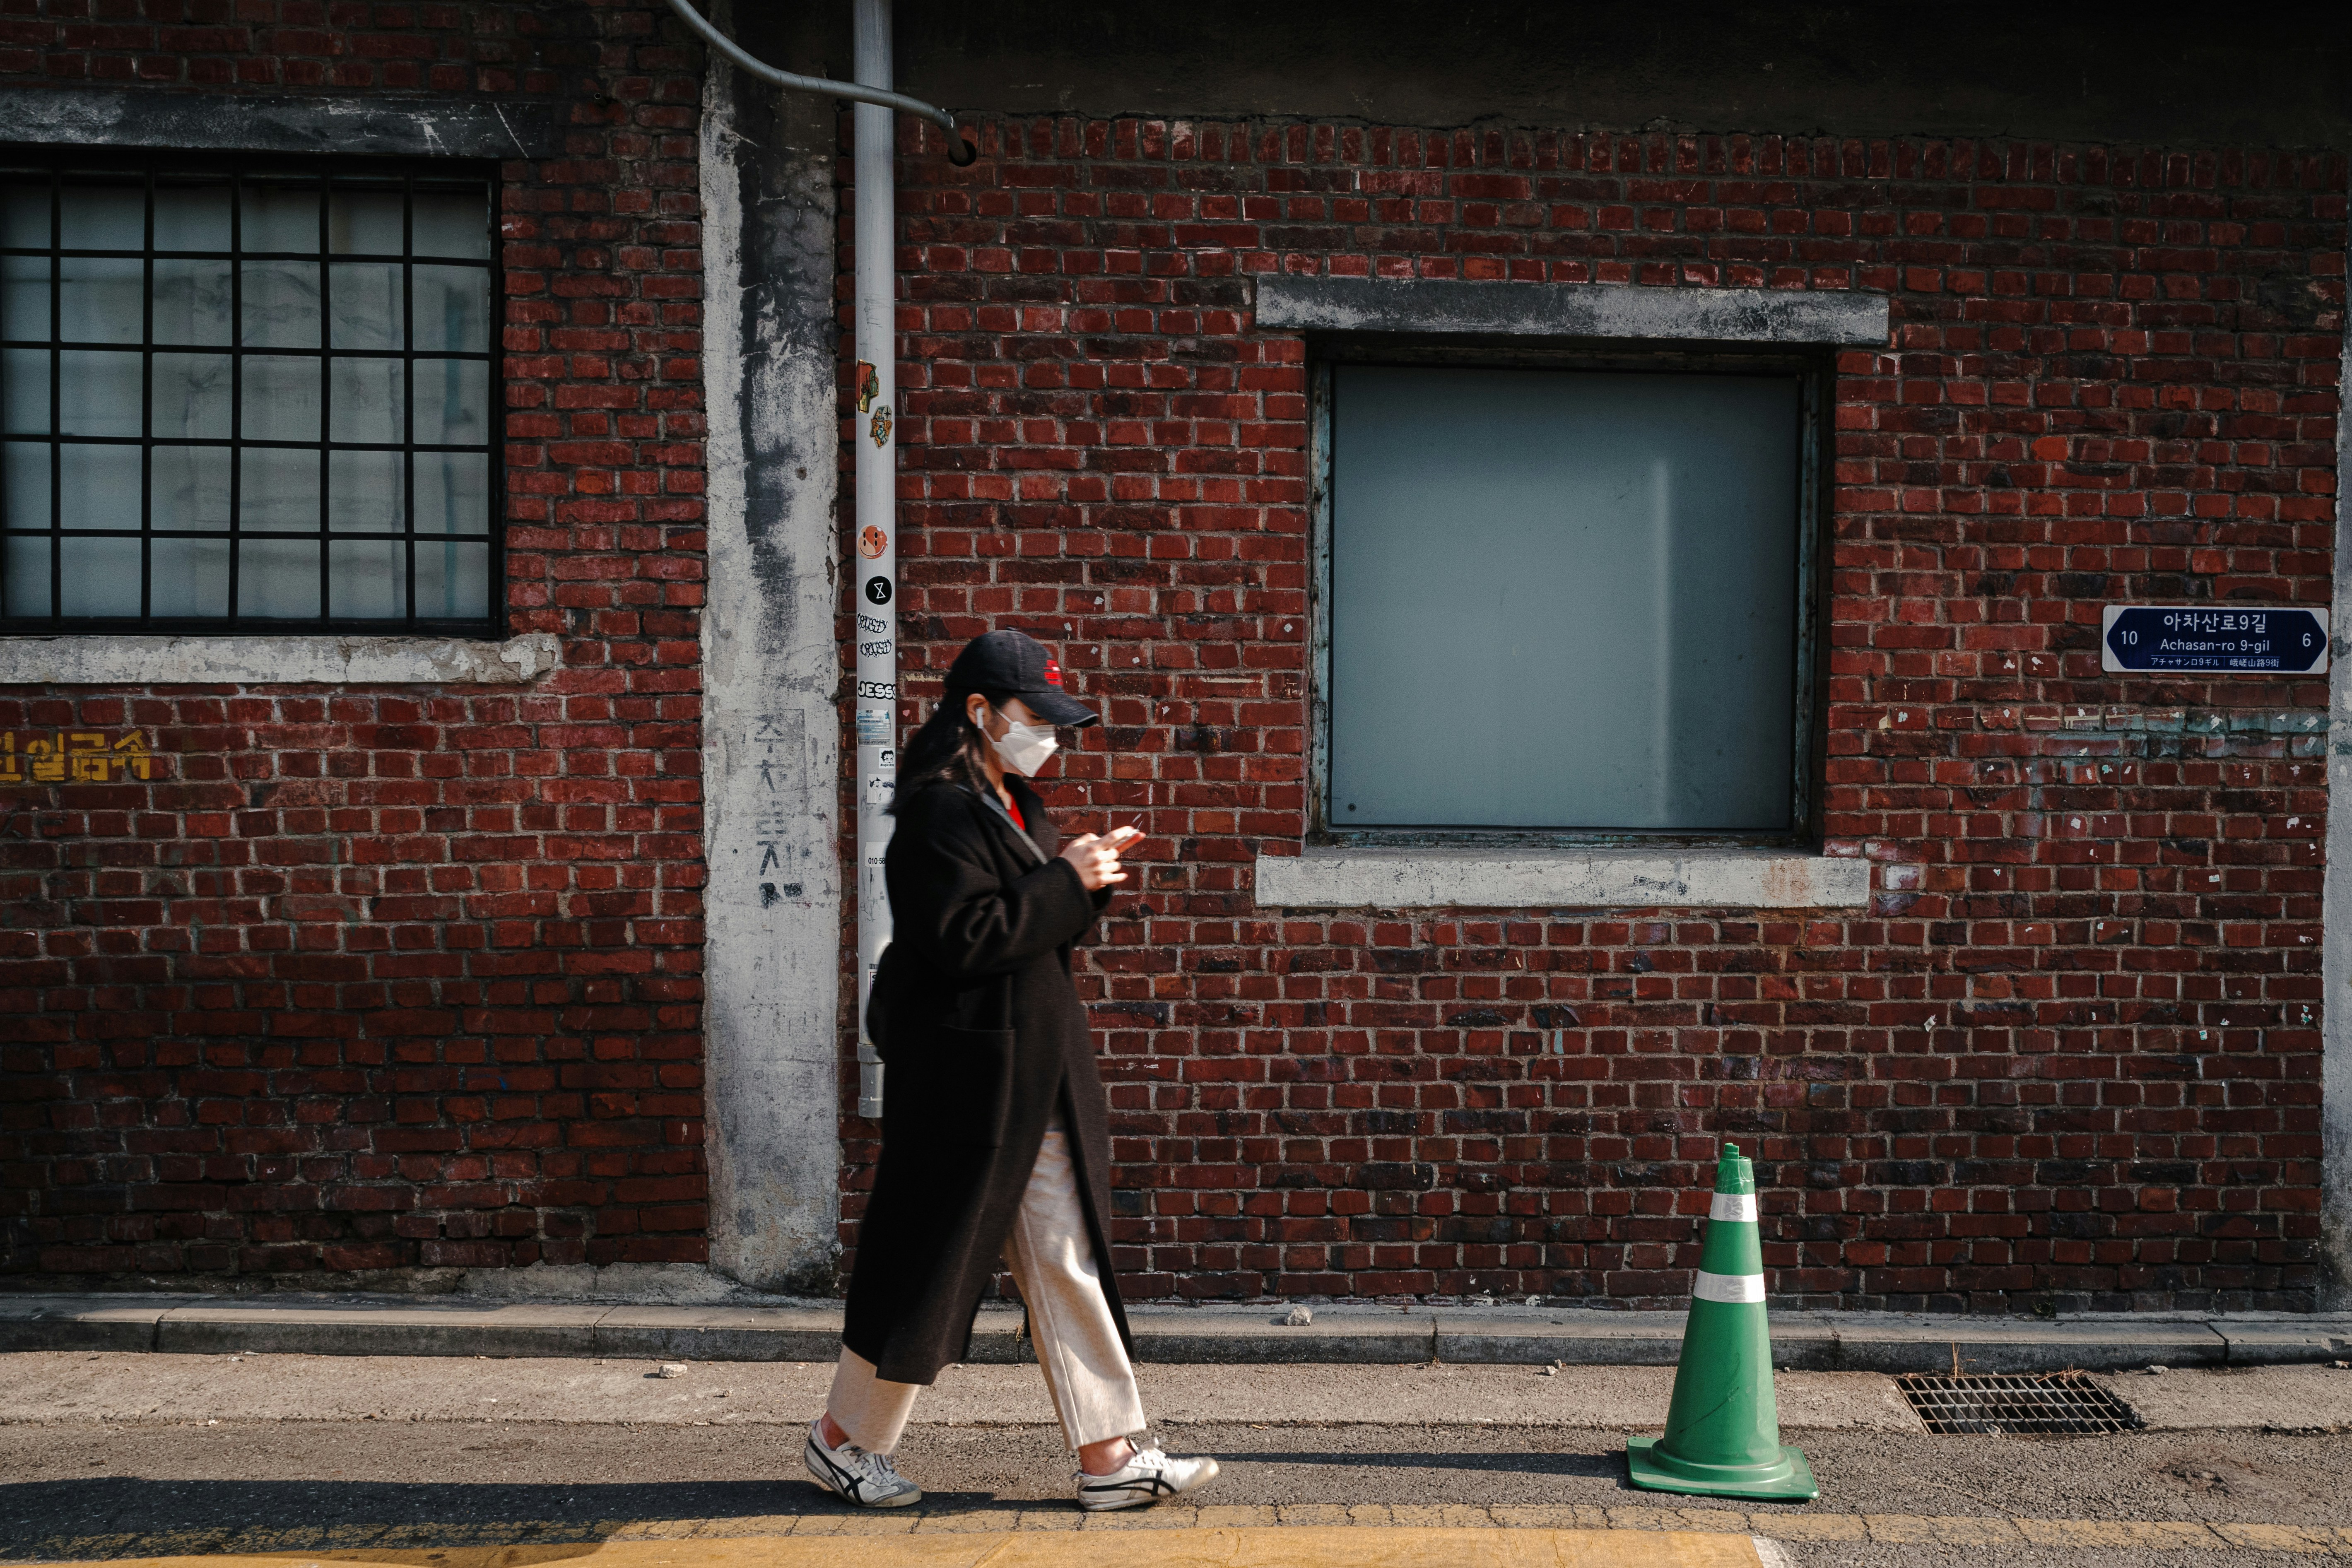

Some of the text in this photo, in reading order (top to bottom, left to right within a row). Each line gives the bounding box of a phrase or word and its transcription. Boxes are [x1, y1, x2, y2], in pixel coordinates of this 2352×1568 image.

[2164, 613, 2266, 633] 아차산로9길
[2121, 631, 2138, 645] 10
[2302, 633, 2311, 647] 6
[2159, 638, 2270, 654] Achasan-ro 9-gil
[2151, 658, 2219, 667] アチャサンロ9ギル
